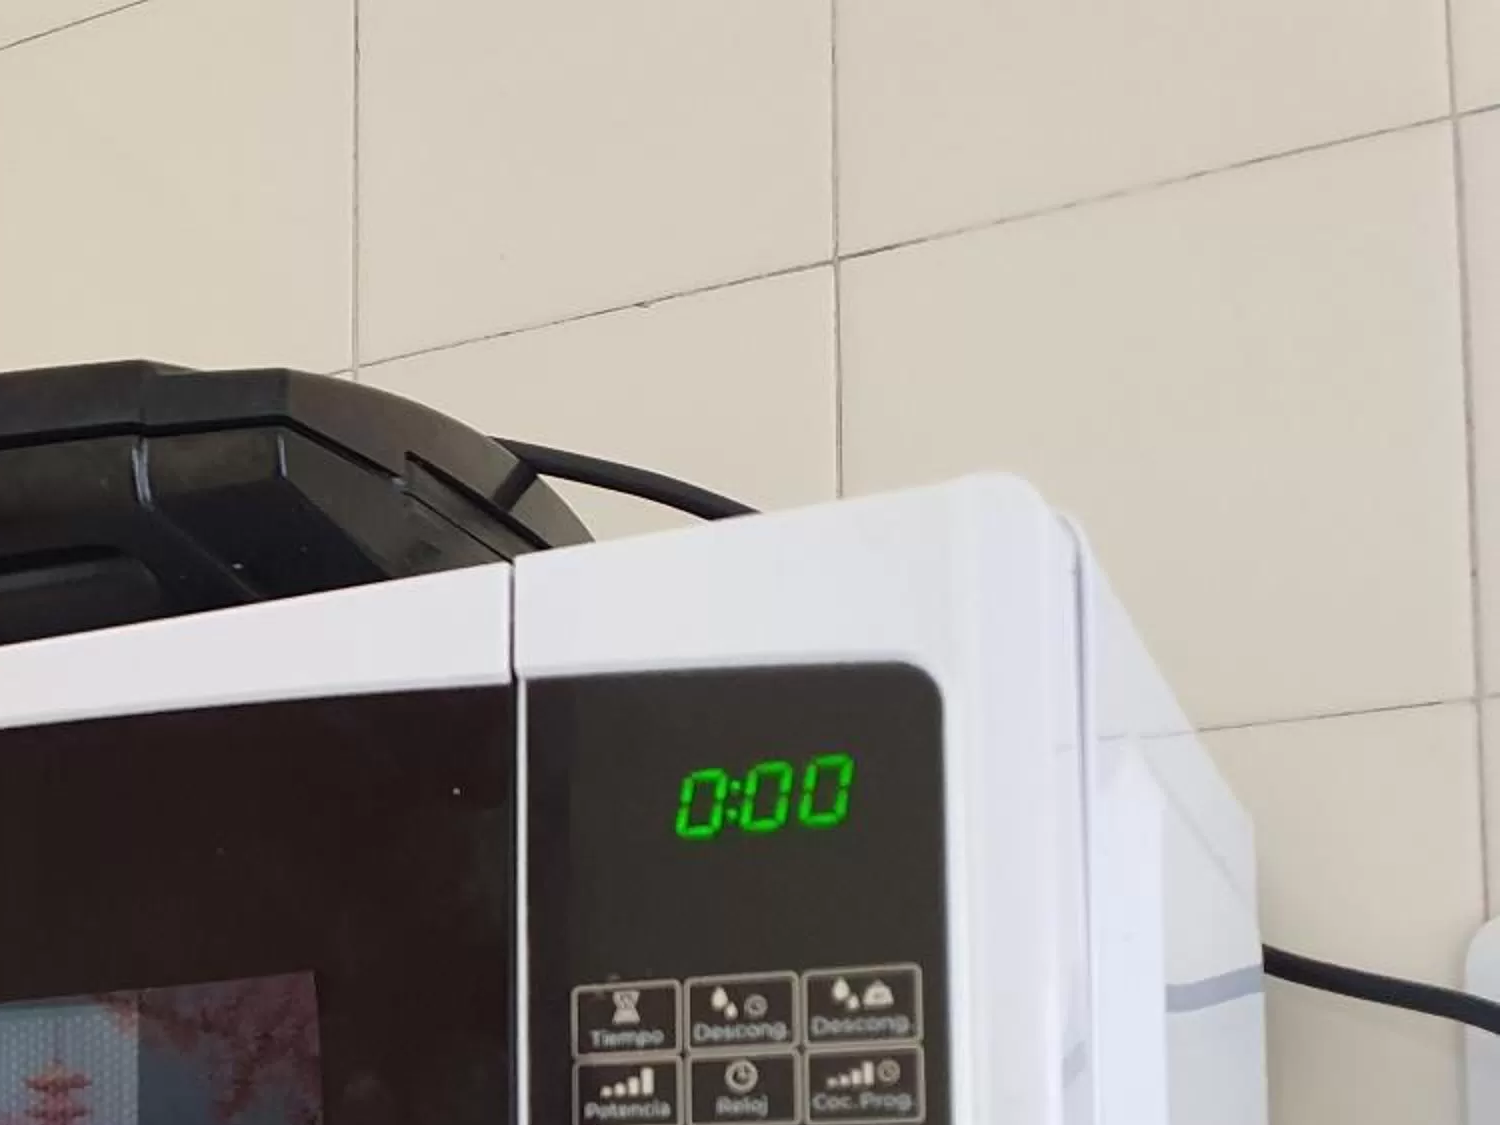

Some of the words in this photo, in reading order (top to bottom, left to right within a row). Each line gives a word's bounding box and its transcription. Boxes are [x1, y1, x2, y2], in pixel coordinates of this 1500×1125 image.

[676, 753, 854, 839] 0:00
[693, 1020, 789, 1042] Descong.
[811, 1014, 914, 1035] Descong.
[590, 1028, 665, 1048] Tiempo
[584, 1101, 671, 1120] Potencia
[716, 1095, 768, 1119] Reloj
